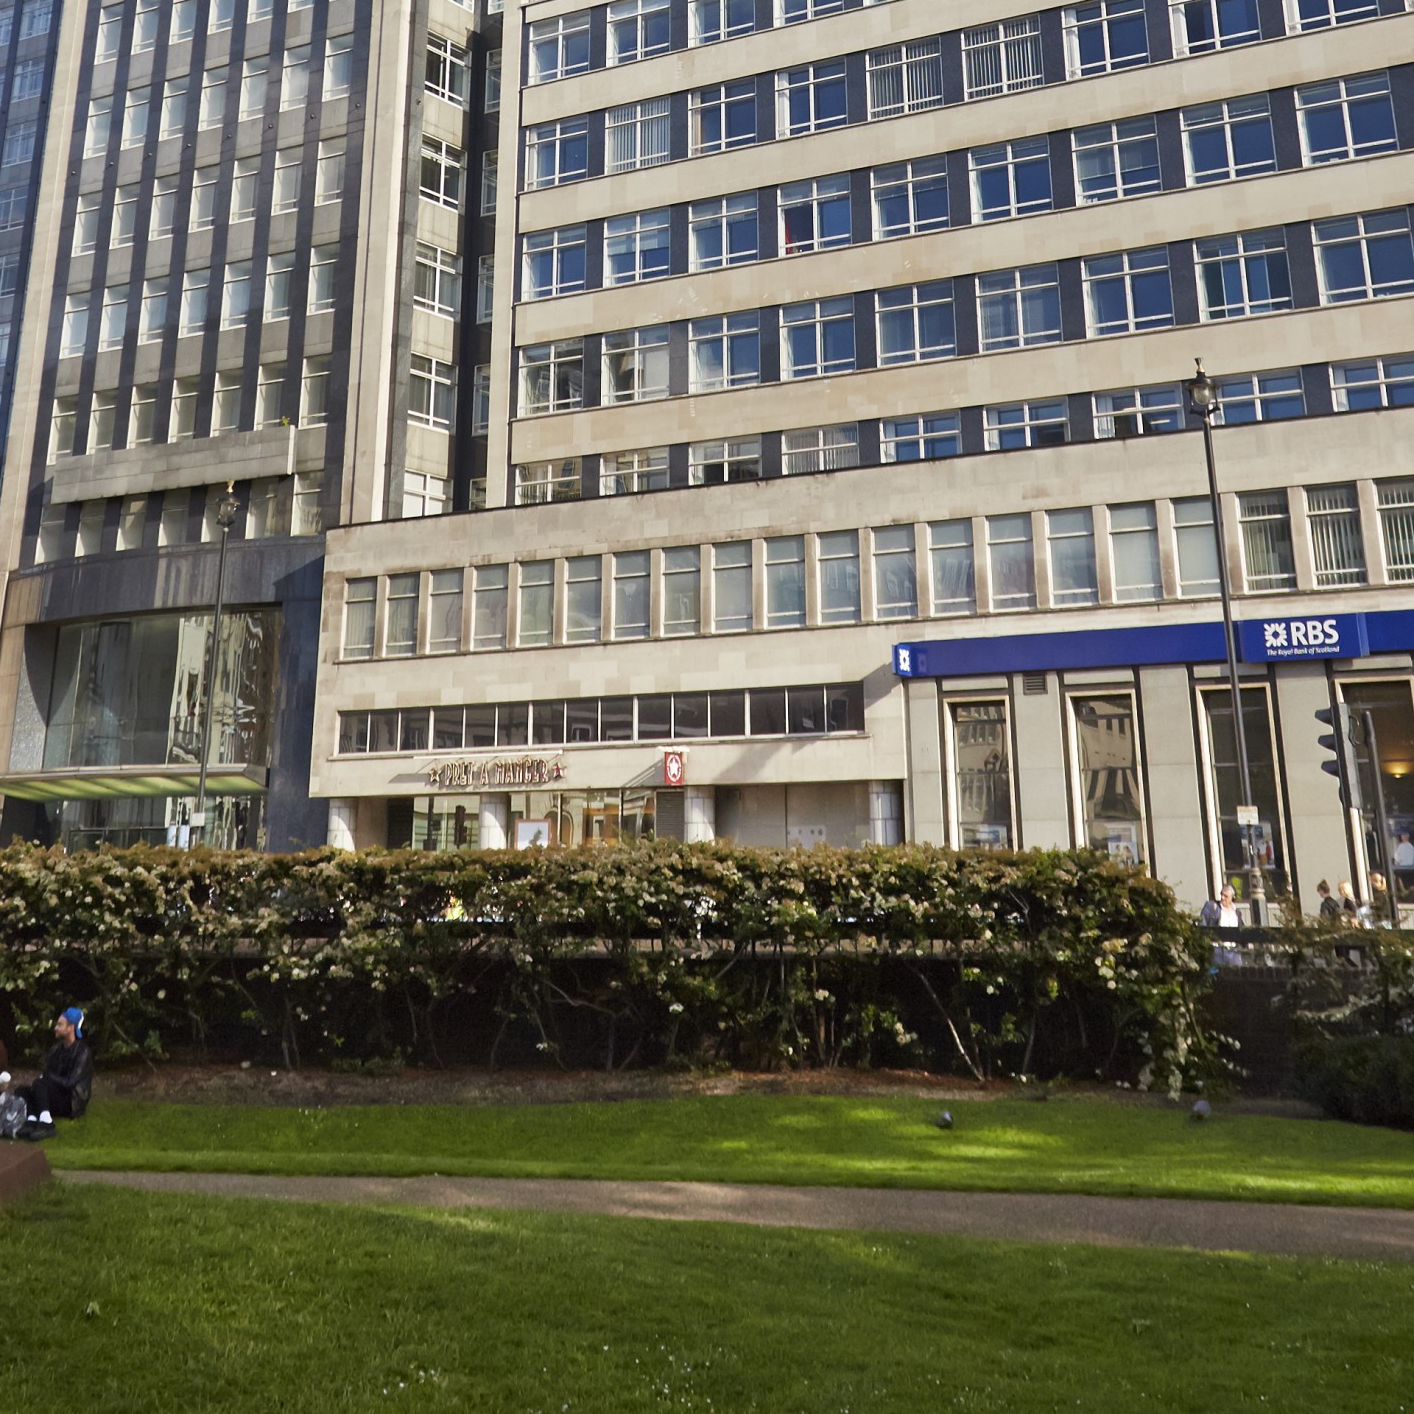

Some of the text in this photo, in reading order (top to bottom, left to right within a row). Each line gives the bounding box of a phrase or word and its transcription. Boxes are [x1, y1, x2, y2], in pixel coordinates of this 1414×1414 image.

[1290, 619, 1339, 646] RBS
[1267, 648, 1277, 656] The
[1278, 648, 1293, 656] Royal
[1294, 647, 1308, 655] Bank
[1308, 647, 1315, 655] of
[445, 757, 549, 785] PRET A MANGER
